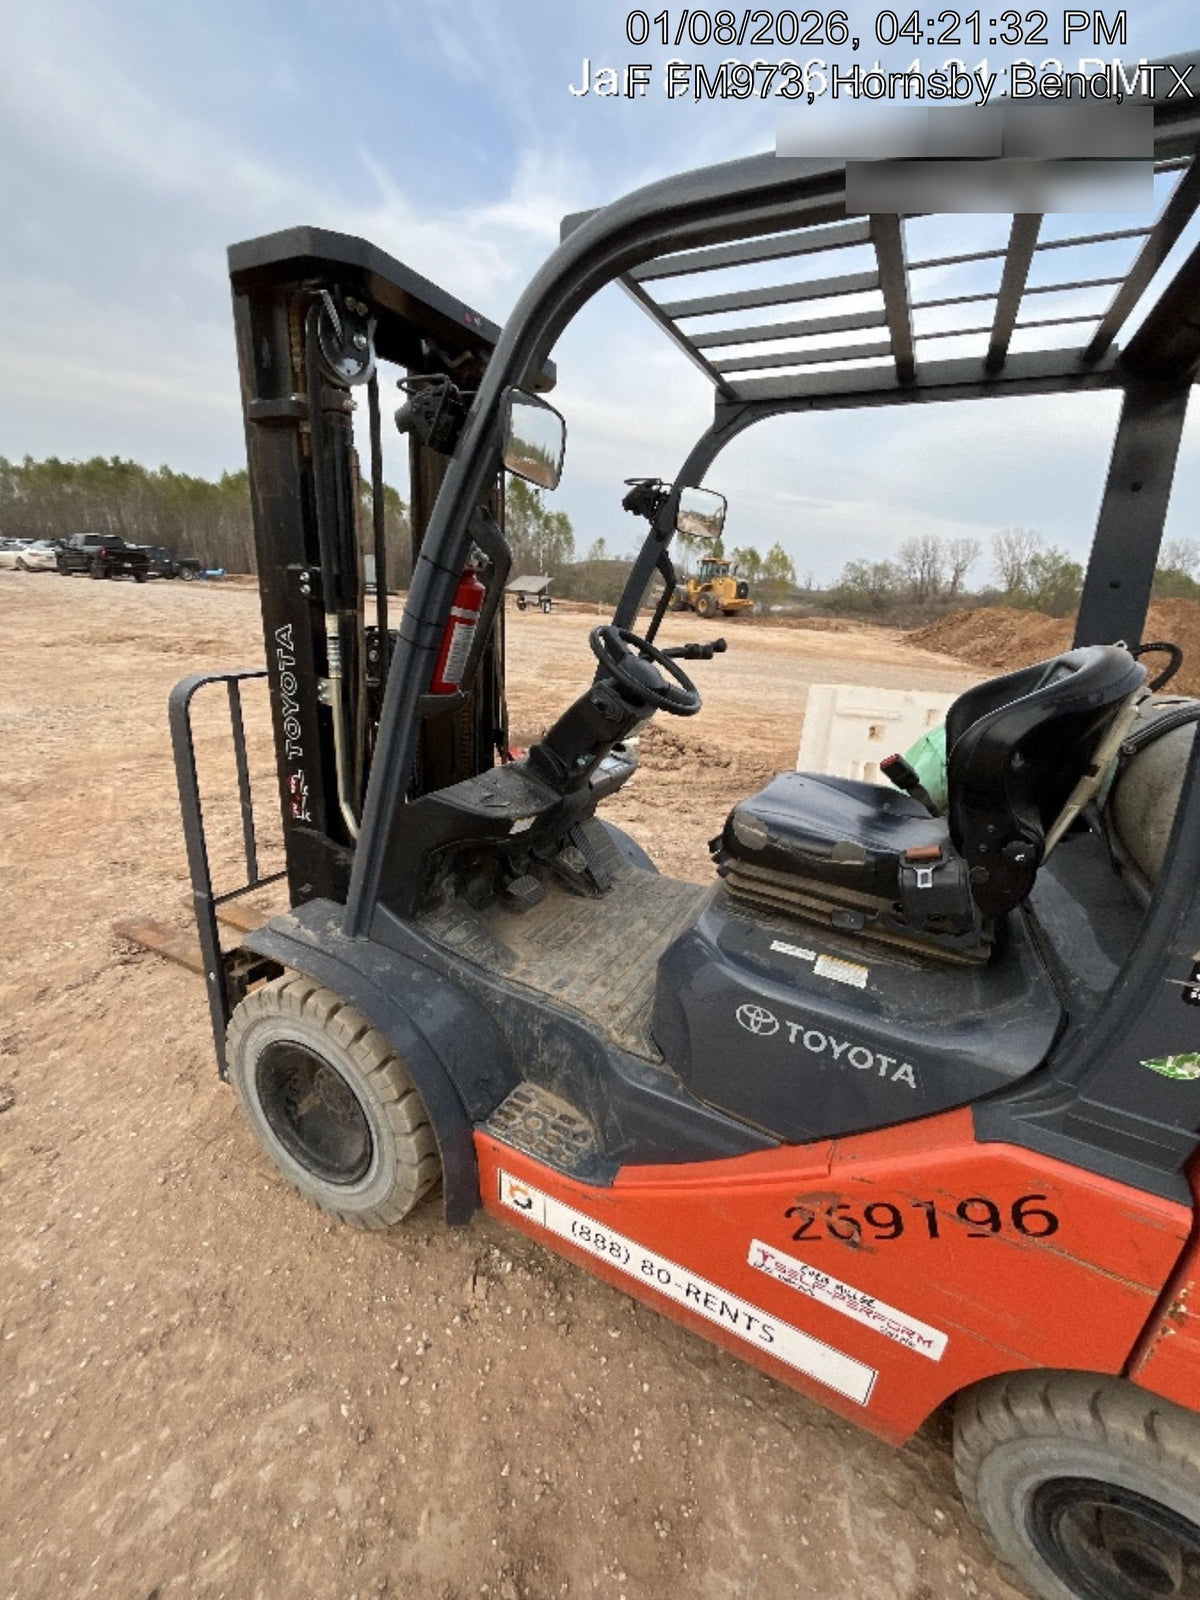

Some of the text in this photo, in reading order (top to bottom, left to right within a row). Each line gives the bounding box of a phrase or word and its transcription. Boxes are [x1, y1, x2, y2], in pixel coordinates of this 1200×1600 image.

[275, 623, 303, 760] TOYOTA
[785, 1020, 917, 1089] TOYOTA
[571, 1220, 631, 1265] (888)
[640, 1258, 775, 1344] 80-RENTS
